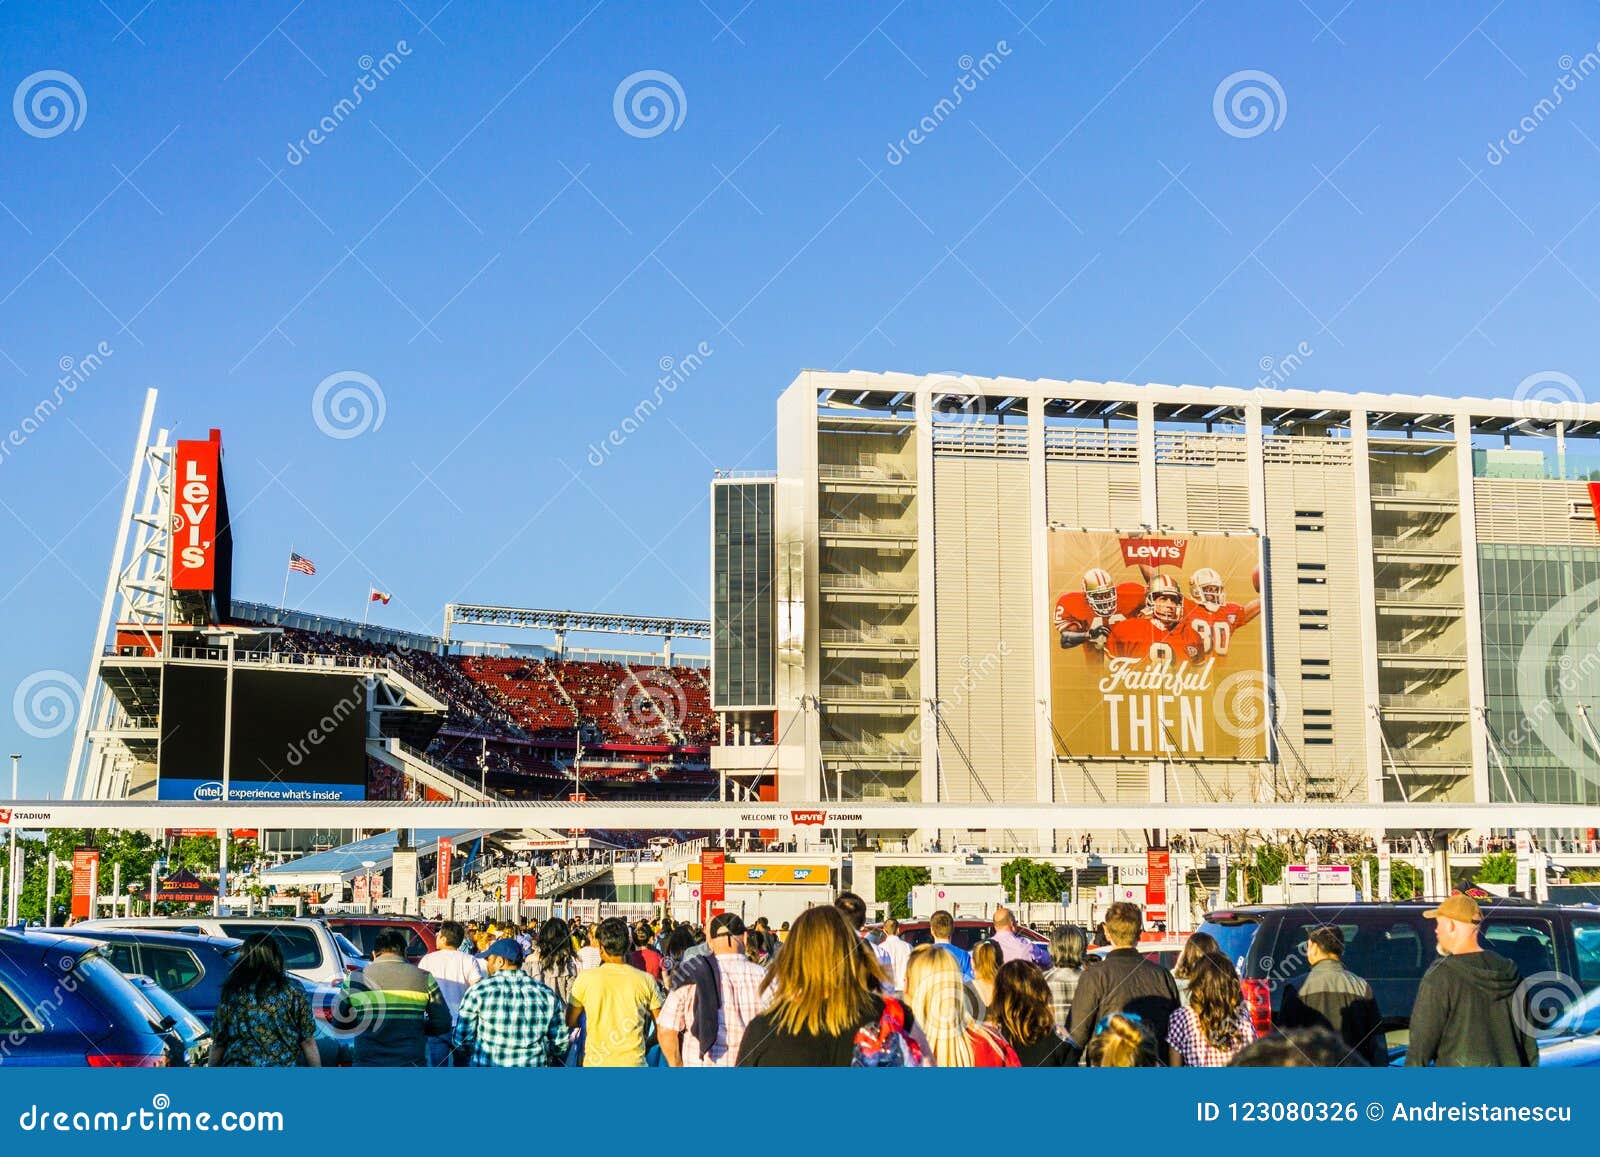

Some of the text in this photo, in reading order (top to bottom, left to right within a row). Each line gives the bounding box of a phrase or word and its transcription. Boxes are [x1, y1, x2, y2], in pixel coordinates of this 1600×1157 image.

[1098, 656, 1216, 696] Faithful
[1103, 693, 1204, 753] THEN
[229, 787, 281, 800] experience
[282, 789, 312, 800] what's
[312, 790, 341, 801] inside
[14, 812, 51, 820] STADIUM
[748, 869, 764, 878] SAP
[794, 870, 809, 879] SAP
[1120, 866, 1148, 877] SUN
